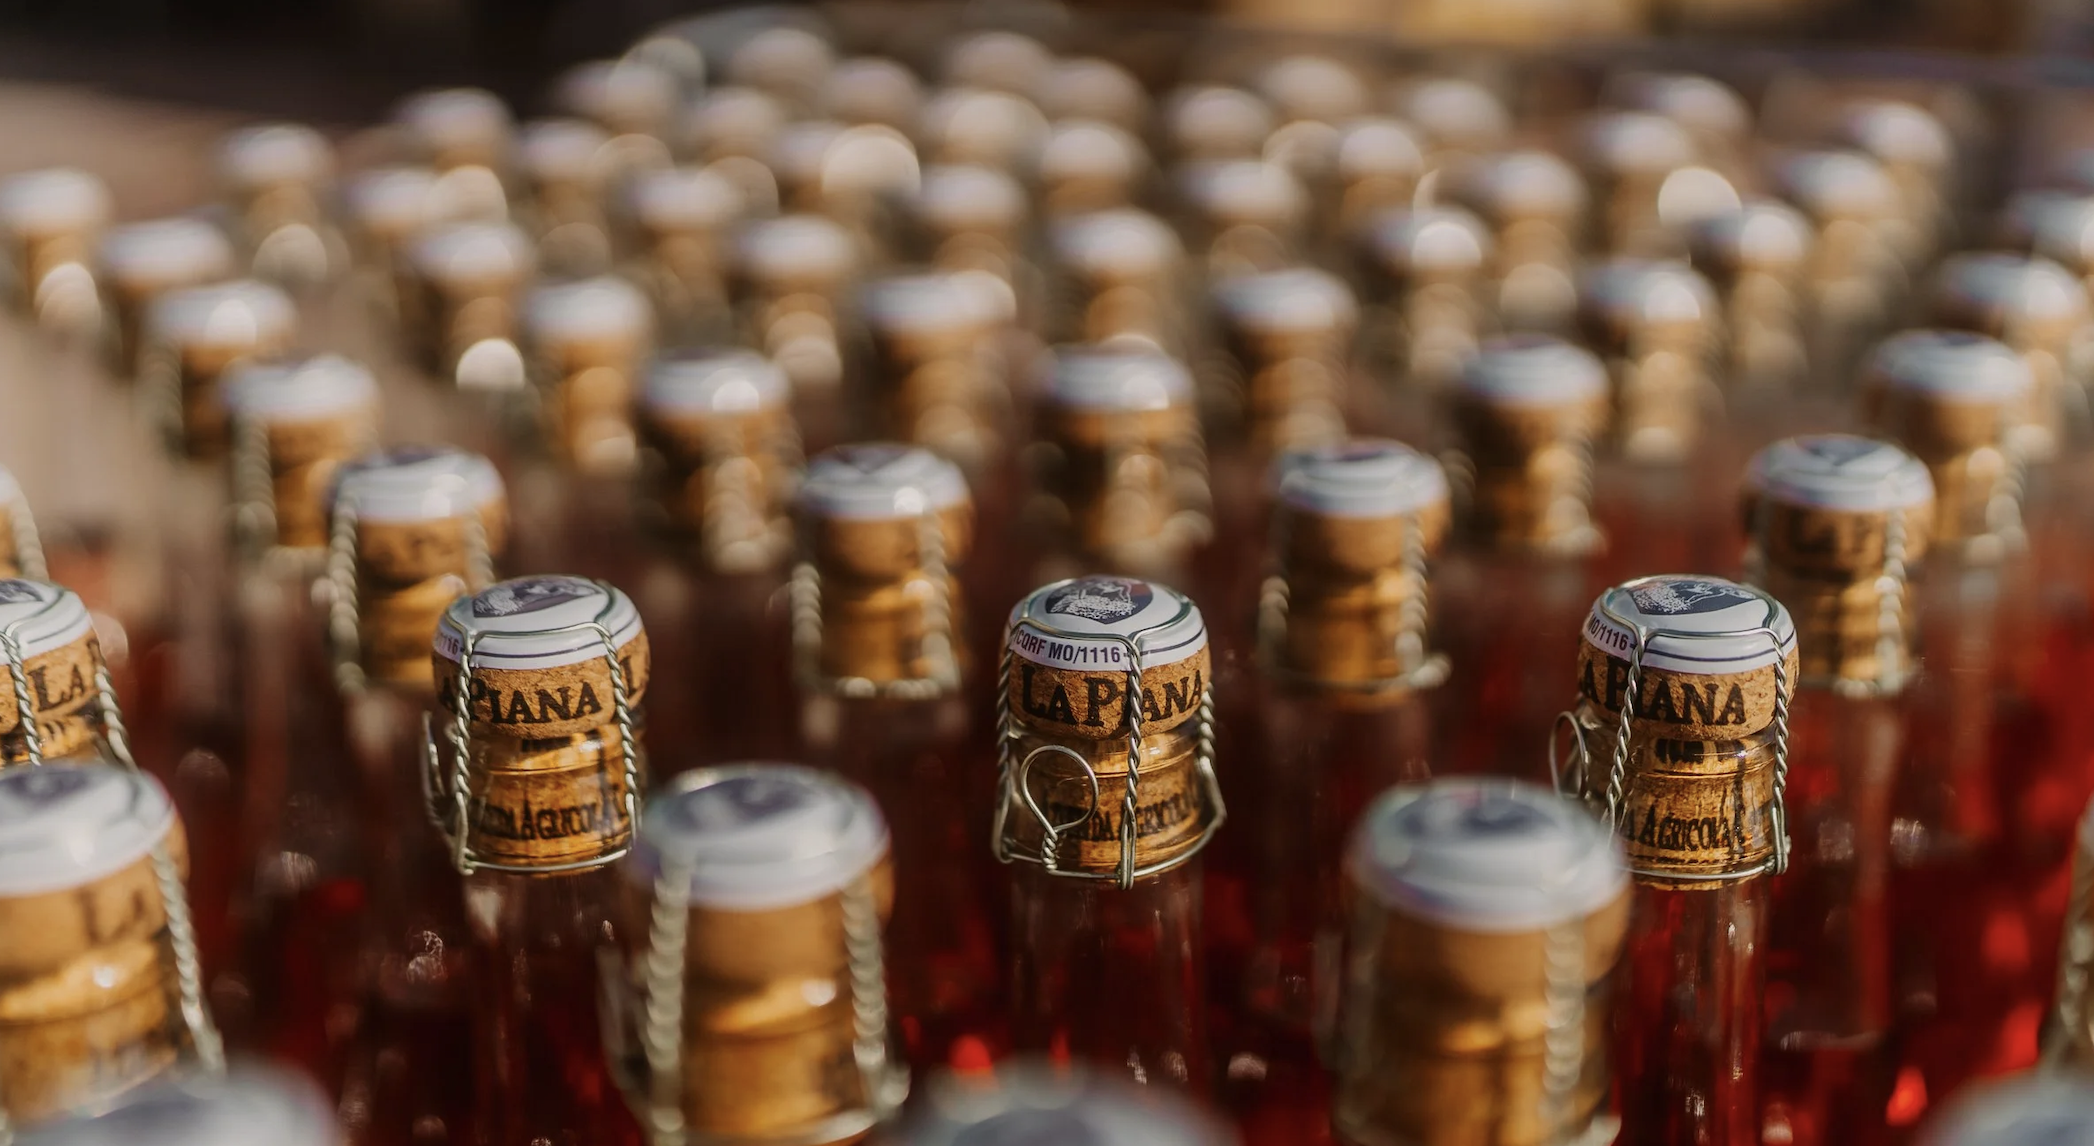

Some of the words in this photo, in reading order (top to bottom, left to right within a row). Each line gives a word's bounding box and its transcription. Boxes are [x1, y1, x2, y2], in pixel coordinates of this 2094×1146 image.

[1048, 642, 1121, 664] MO/1116
[27, 664, 86, 712] LA
[469, 678, 603, 724] PIANA
[1020, 663, 1078, 726] LA
[1082, 669, 1202, 728] PIANA
[1604, 654, 1746, 726] PIANA
